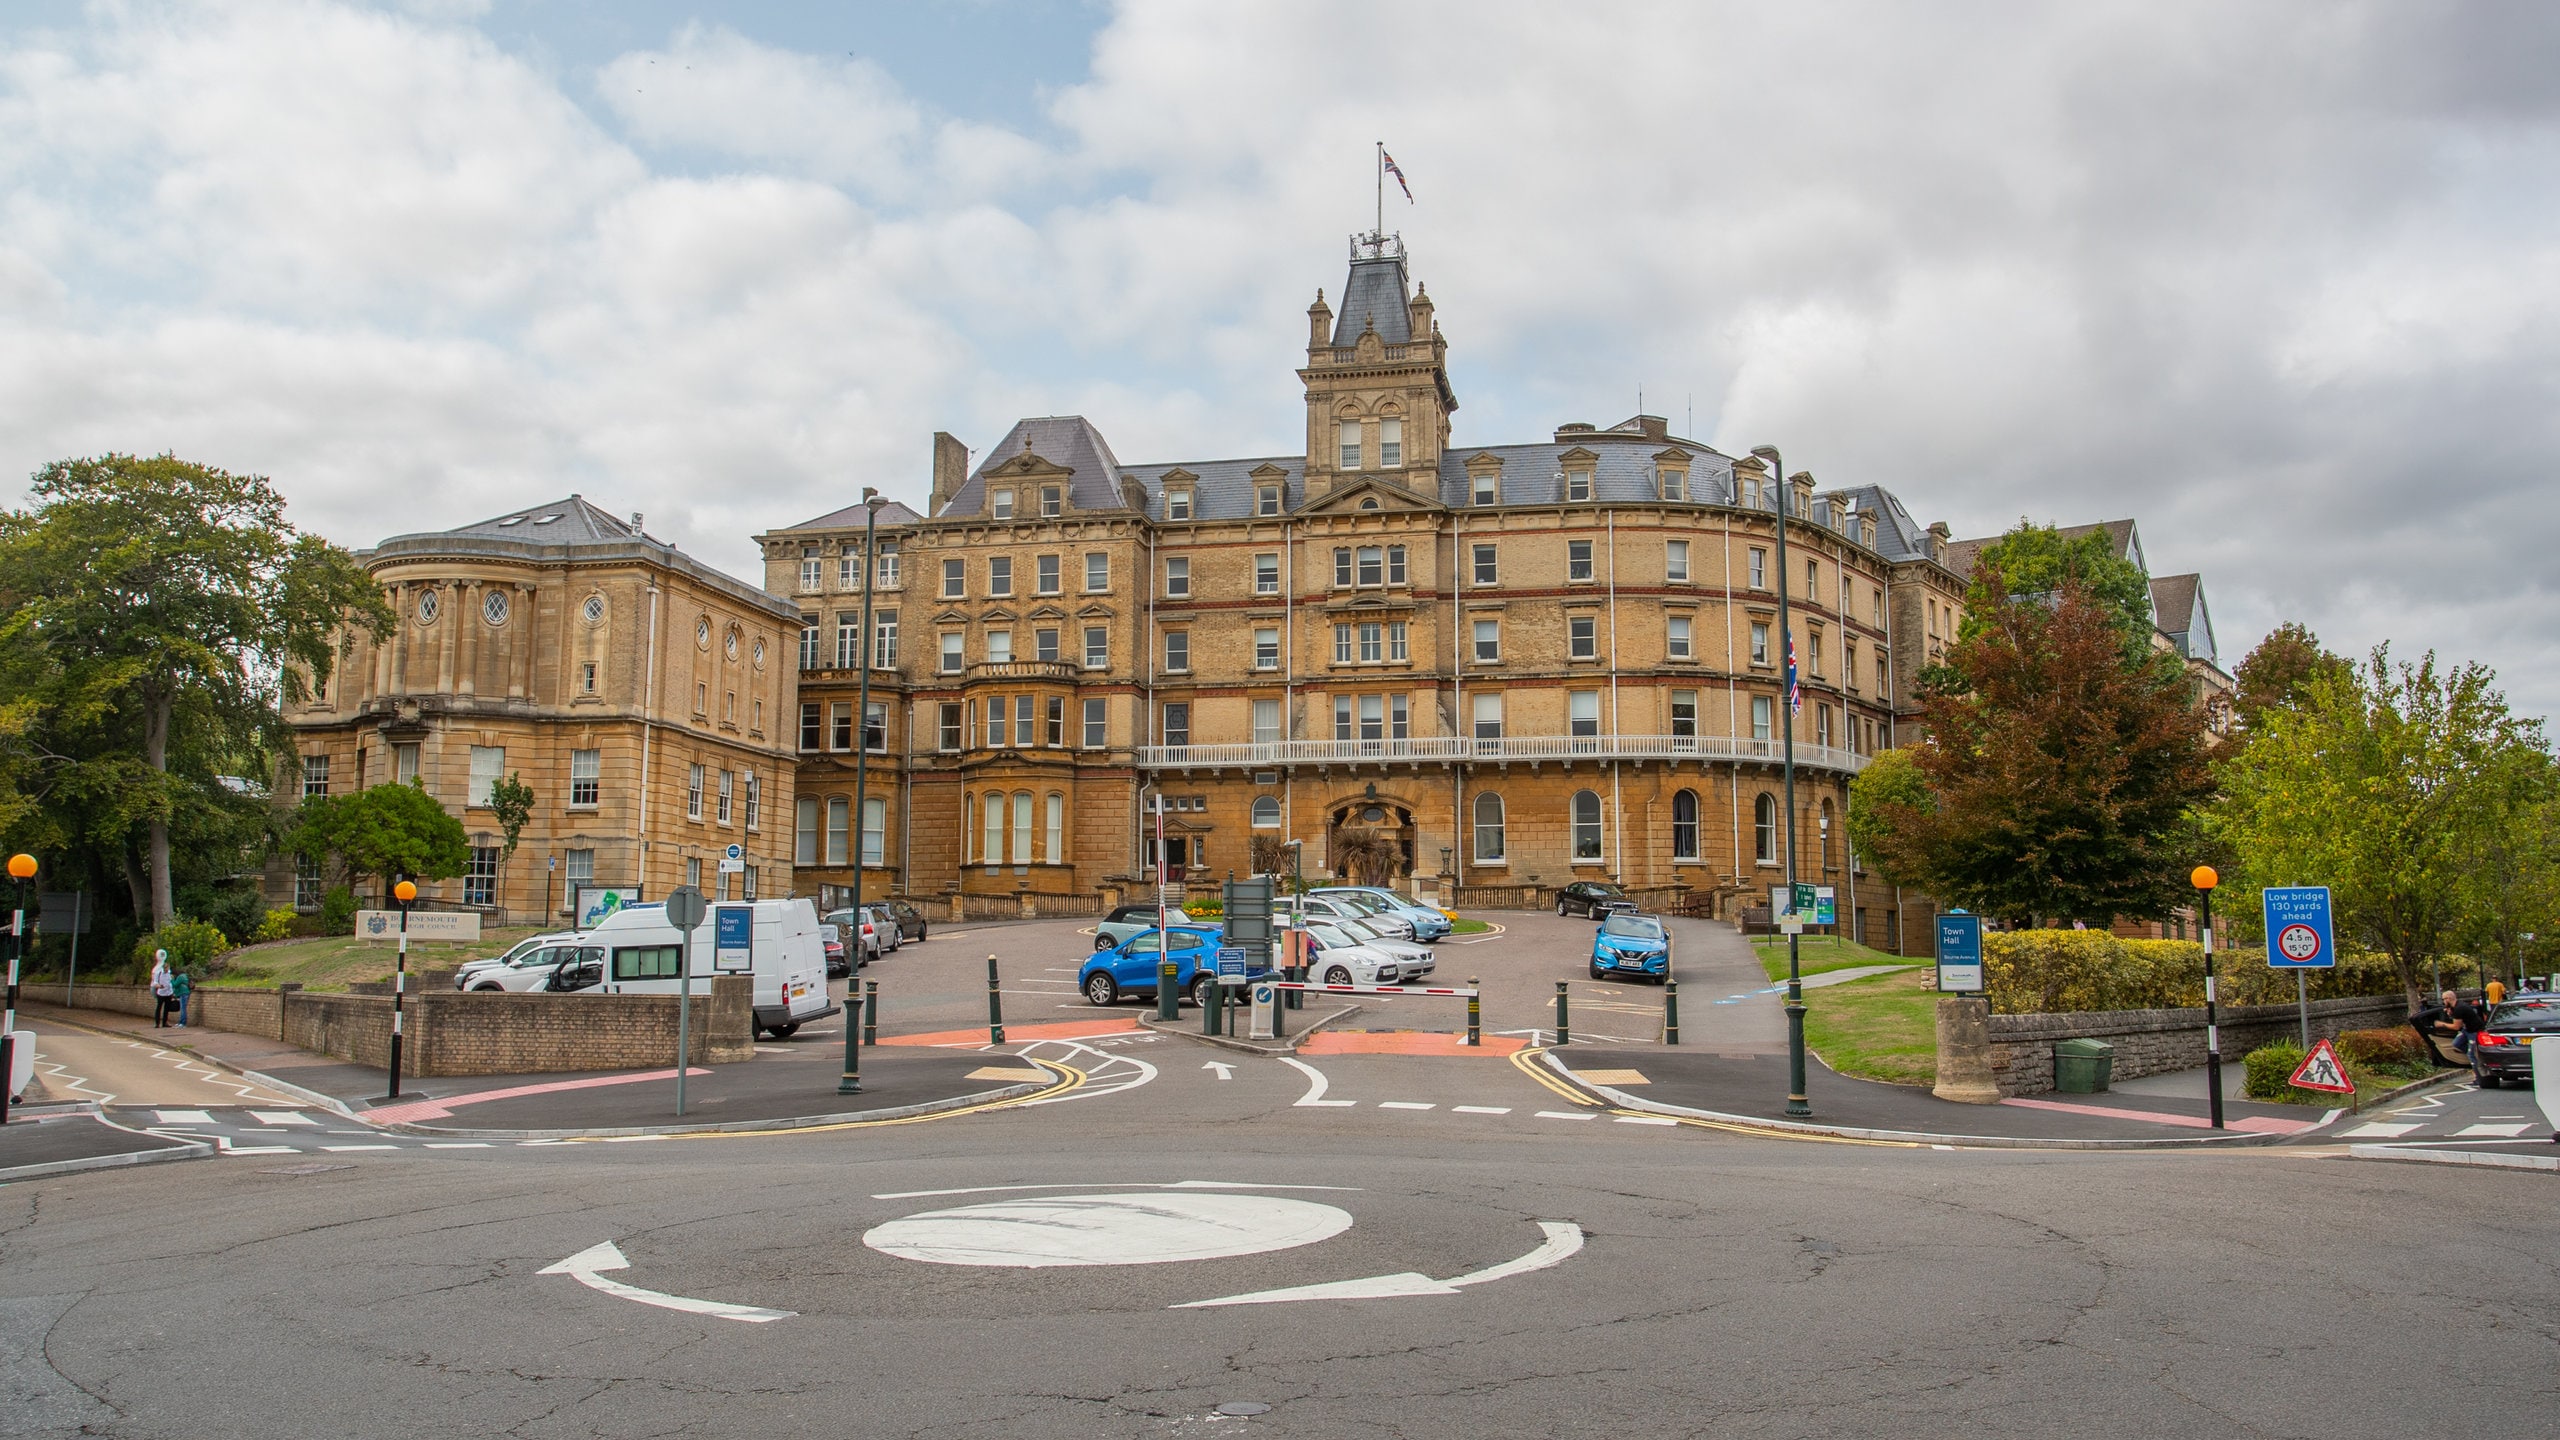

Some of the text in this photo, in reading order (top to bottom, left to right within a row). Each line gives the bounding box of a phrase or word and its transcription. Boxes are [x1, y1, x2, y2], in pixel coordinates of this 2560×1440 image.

[2268, 892, 2324, 902] Low bridge
[2272, 902, 2321, 912] 130 yards
[391, 915, 457, 923] BORNEMOUTH
[2282, 912, 2312, 920] ahead
[1943, 927, 1965, 935] Town
[1944, 937, 1960, 945] Hall
[2286, 933, 2303, 942] 4.5
